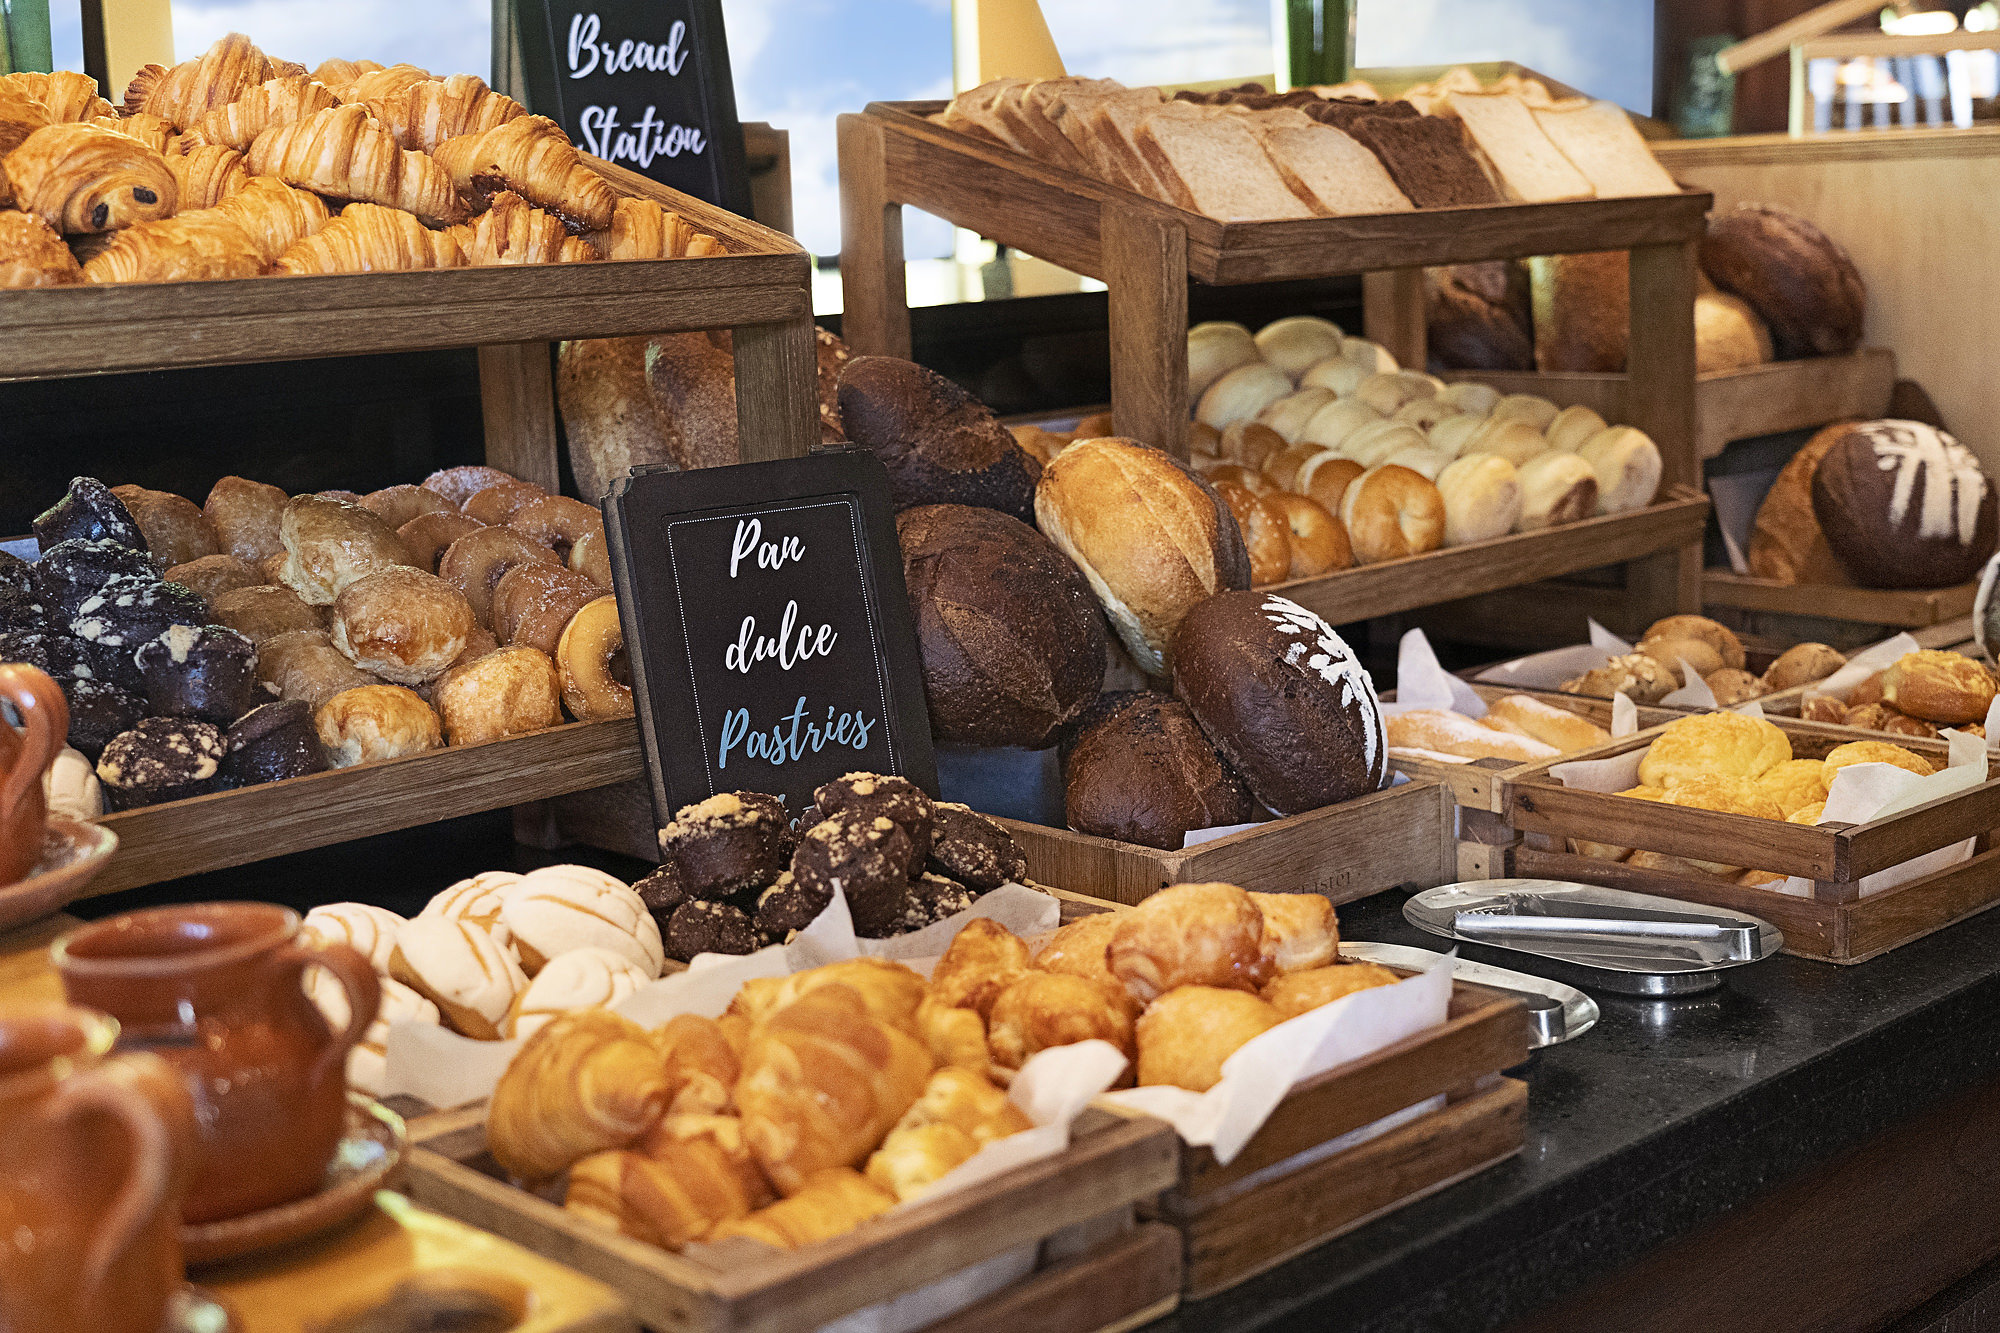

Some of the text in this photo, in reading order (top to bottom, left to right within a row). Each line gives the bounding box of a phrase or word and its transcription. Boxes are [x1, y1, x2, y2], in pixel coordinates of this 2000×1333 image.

[567, 13, 689, 79] Bread
[577, 105, 707, 169] Station
[729, 518, 806, 578] Pan
[725, 600, 838, 674] dulce
[718, 696, 875, 769] Pastries
